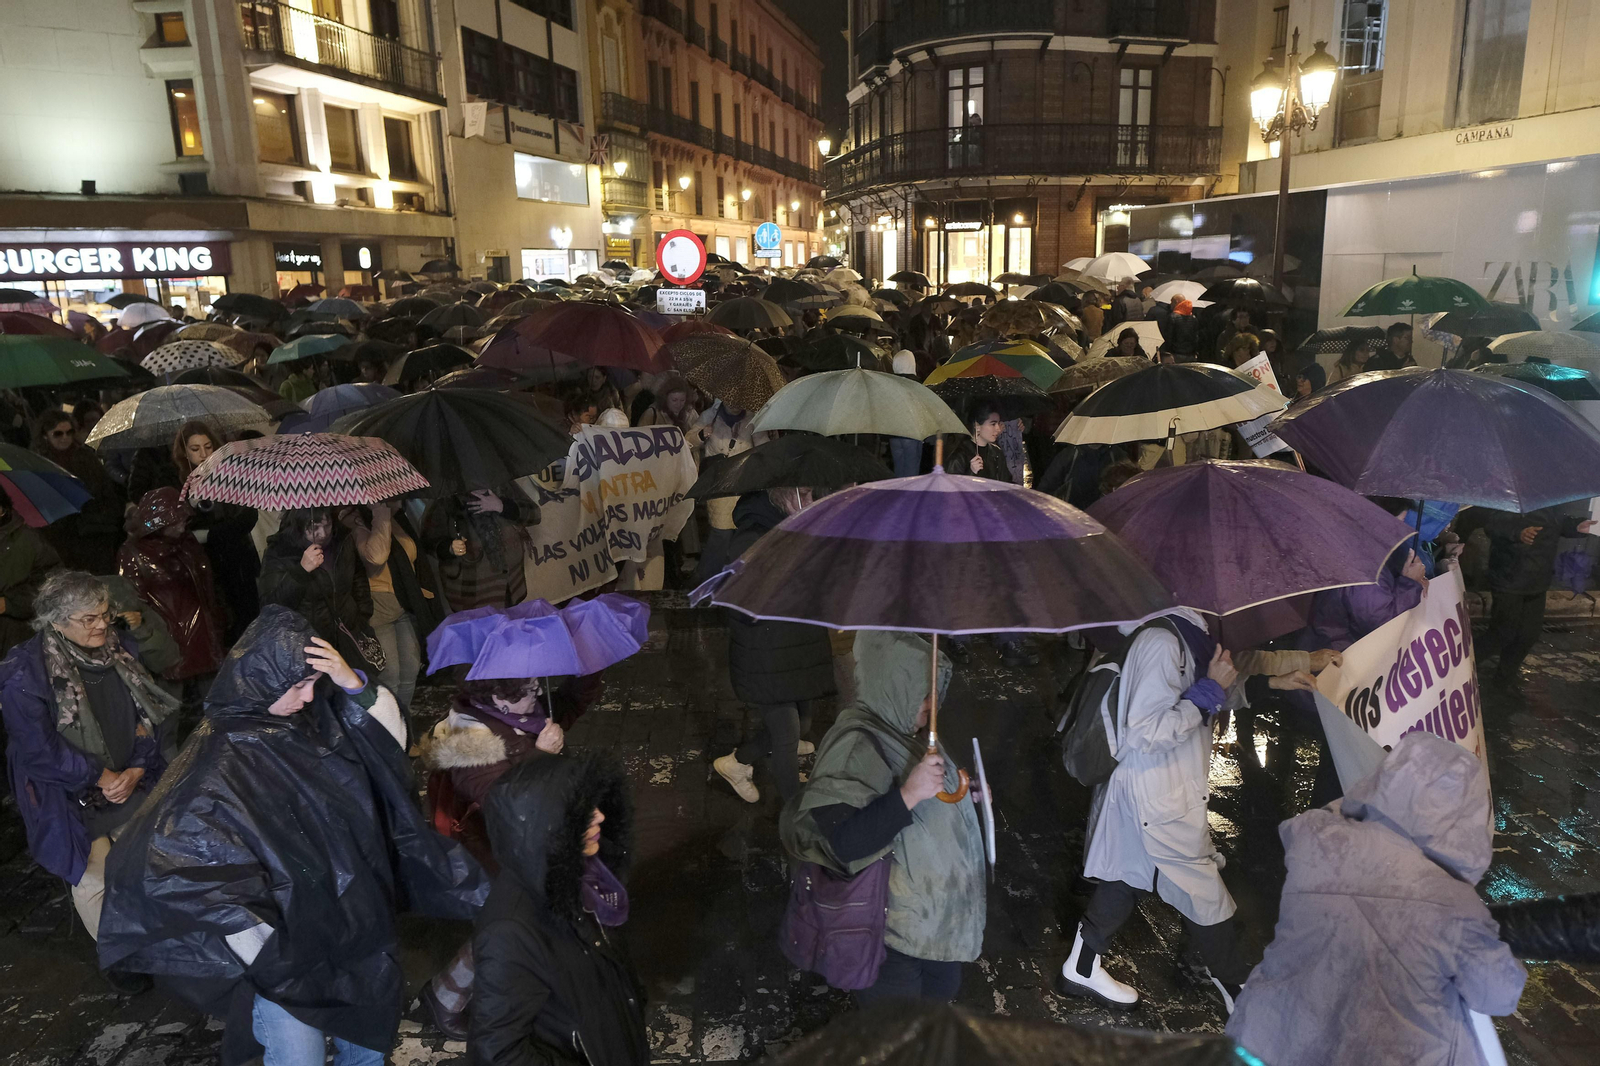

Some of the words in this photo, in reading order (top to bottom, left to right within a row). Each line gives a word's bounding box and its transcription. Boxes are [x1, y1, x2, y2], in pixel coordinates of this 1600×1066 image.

[1455, 127, 1510, 143] CAMPANA
[132, 246, 213, 272] KING
[1484, 261, 1578, 323] ZARA
[531, 541, 568, 567] LAS
[568, 558, 589, 587] NI
[608, 528, 642, 551] ASO
[1385, 599, 1474, 713] derech
